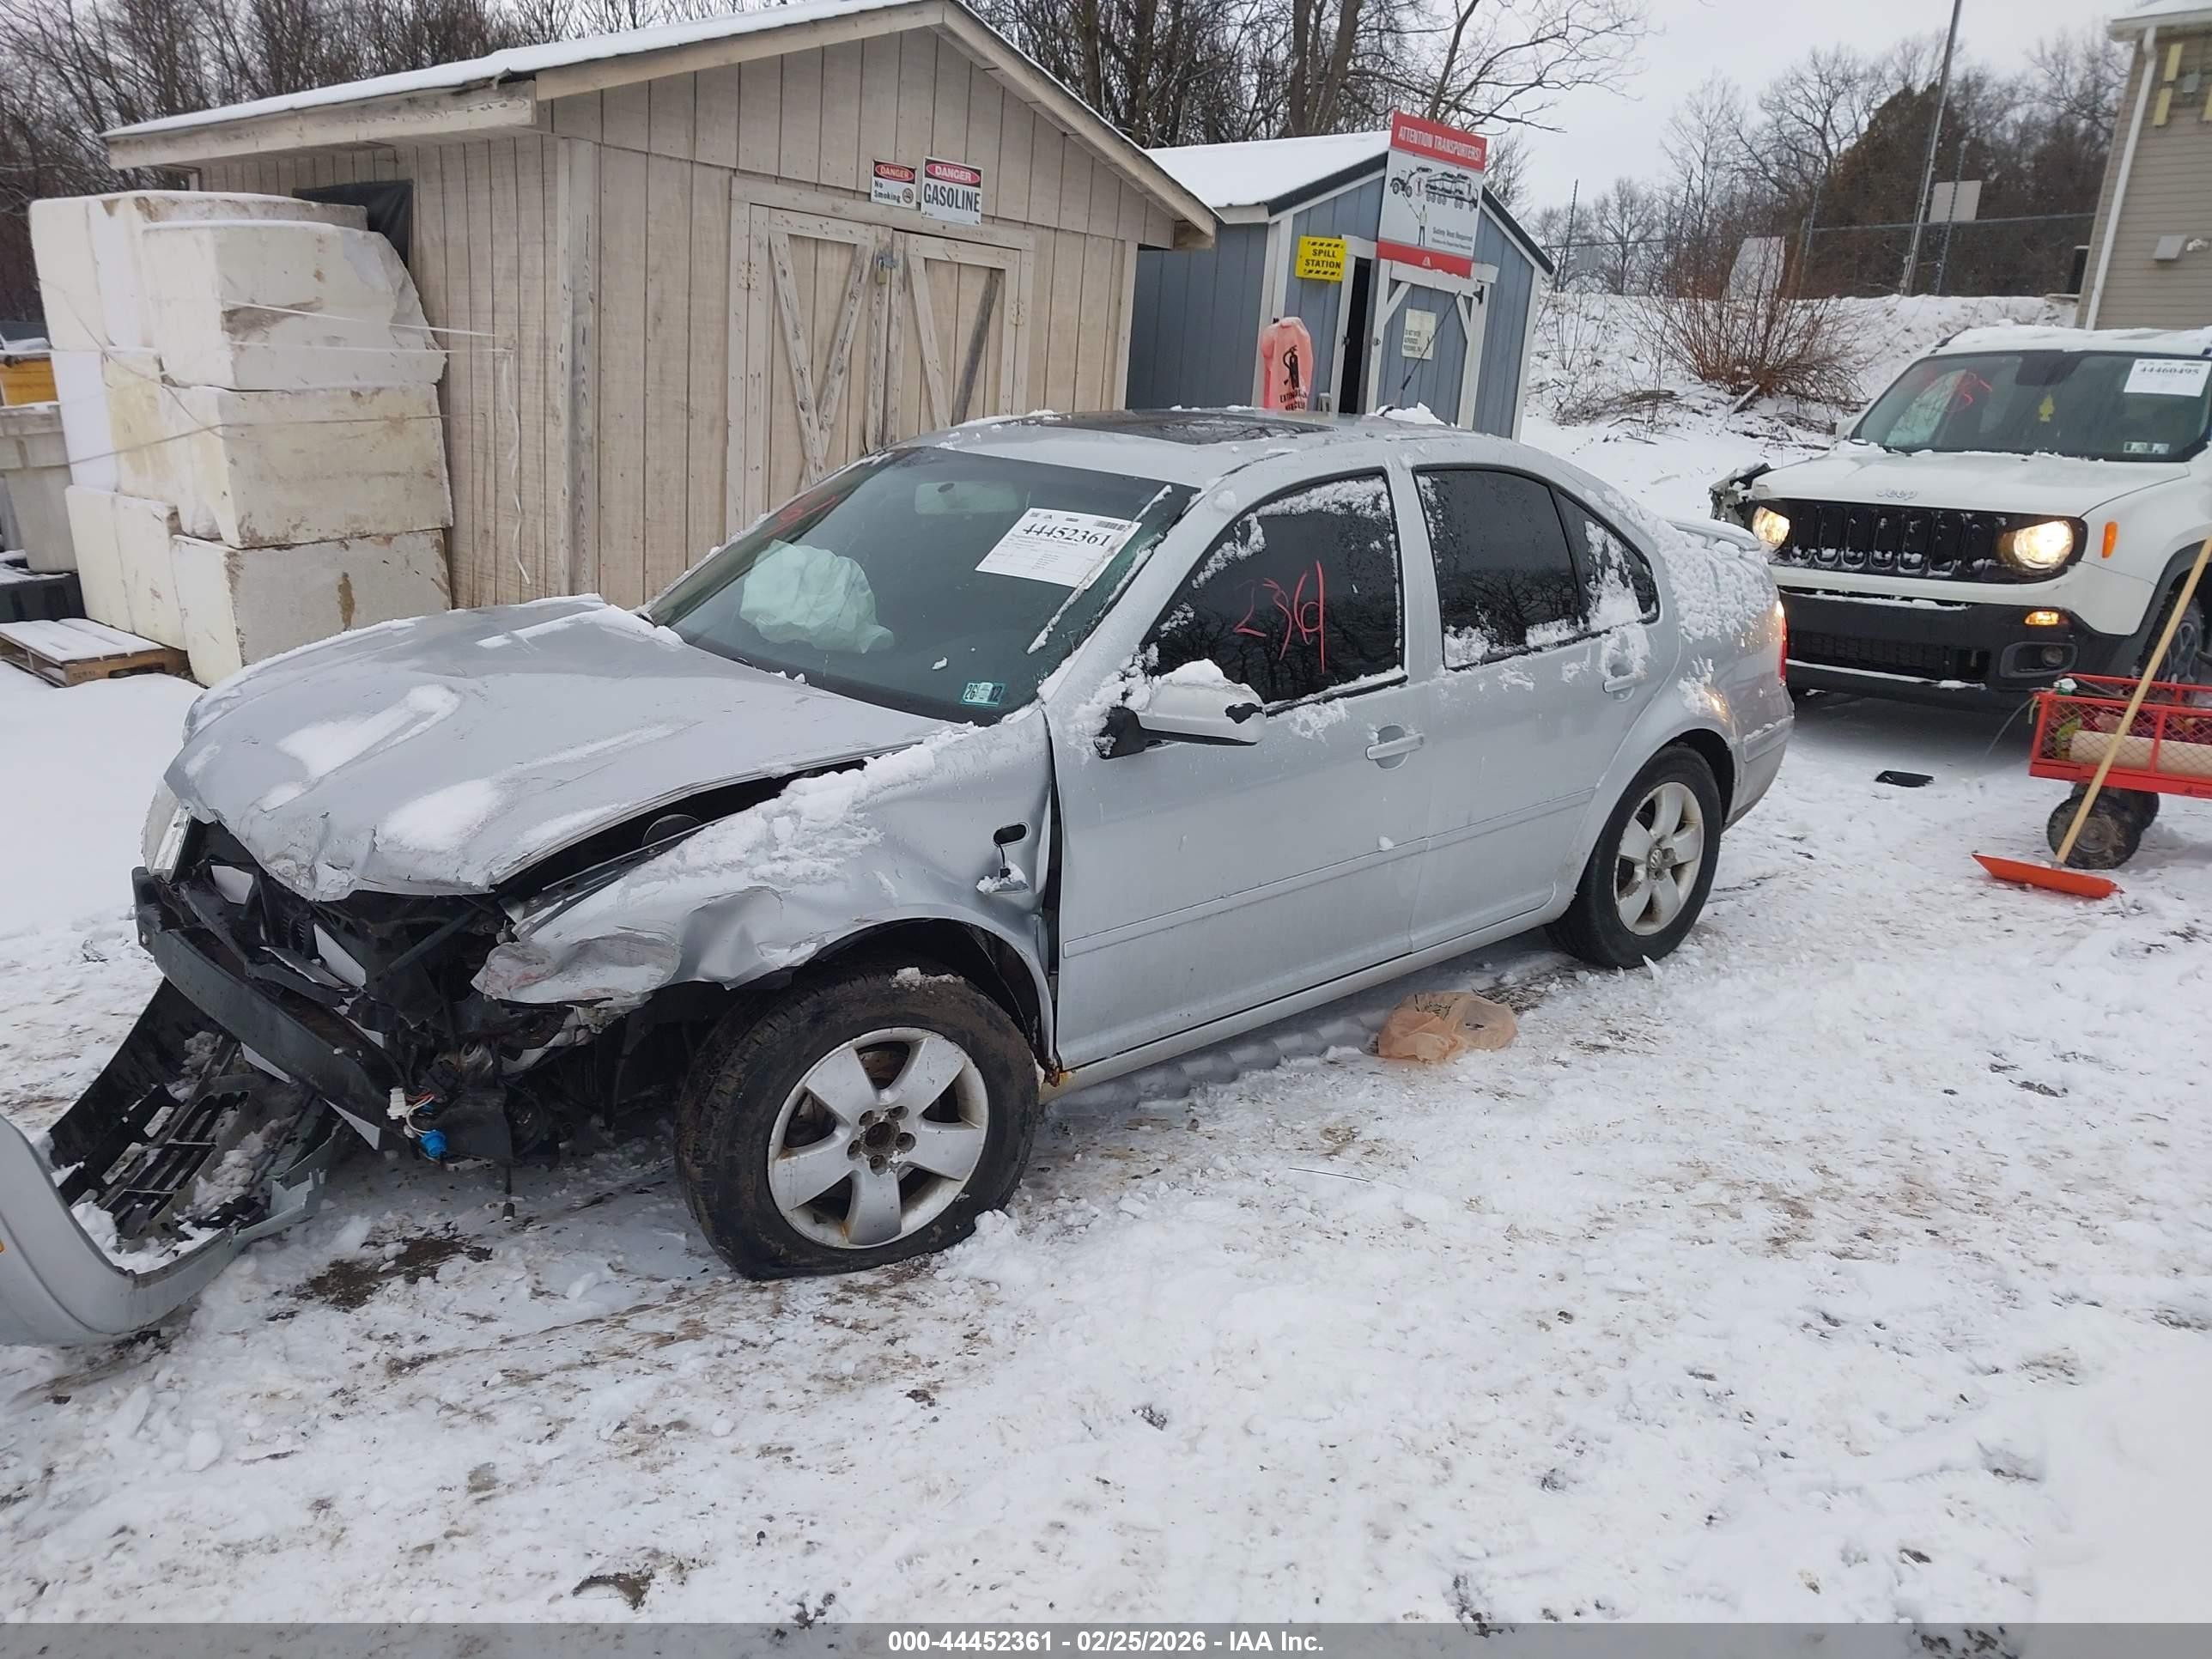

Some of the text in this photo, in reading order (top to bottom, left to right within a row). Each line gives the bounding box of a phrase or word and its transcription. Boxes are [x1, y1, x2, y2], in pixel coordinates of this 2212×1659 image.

[1398, 126, 1482, 161] ATTENTION TRANSPORTERS!
[880, 166, 909, 179] DANGER
[935, 166, 971, 182] DANGER
[874, 191, 901, 204] Smoking
[924, 183, 981, 213] GASOLINE
[1312, 249, 1337, 258] SPILL
[1305, 258, 1341, 269] STATION
[1875, 488, 1918, 501] Jeep
[1023, 523, 1112, 547] 44452361
[964, 684, 978, 700] 26
[988, 686, 1003, 702] 12
